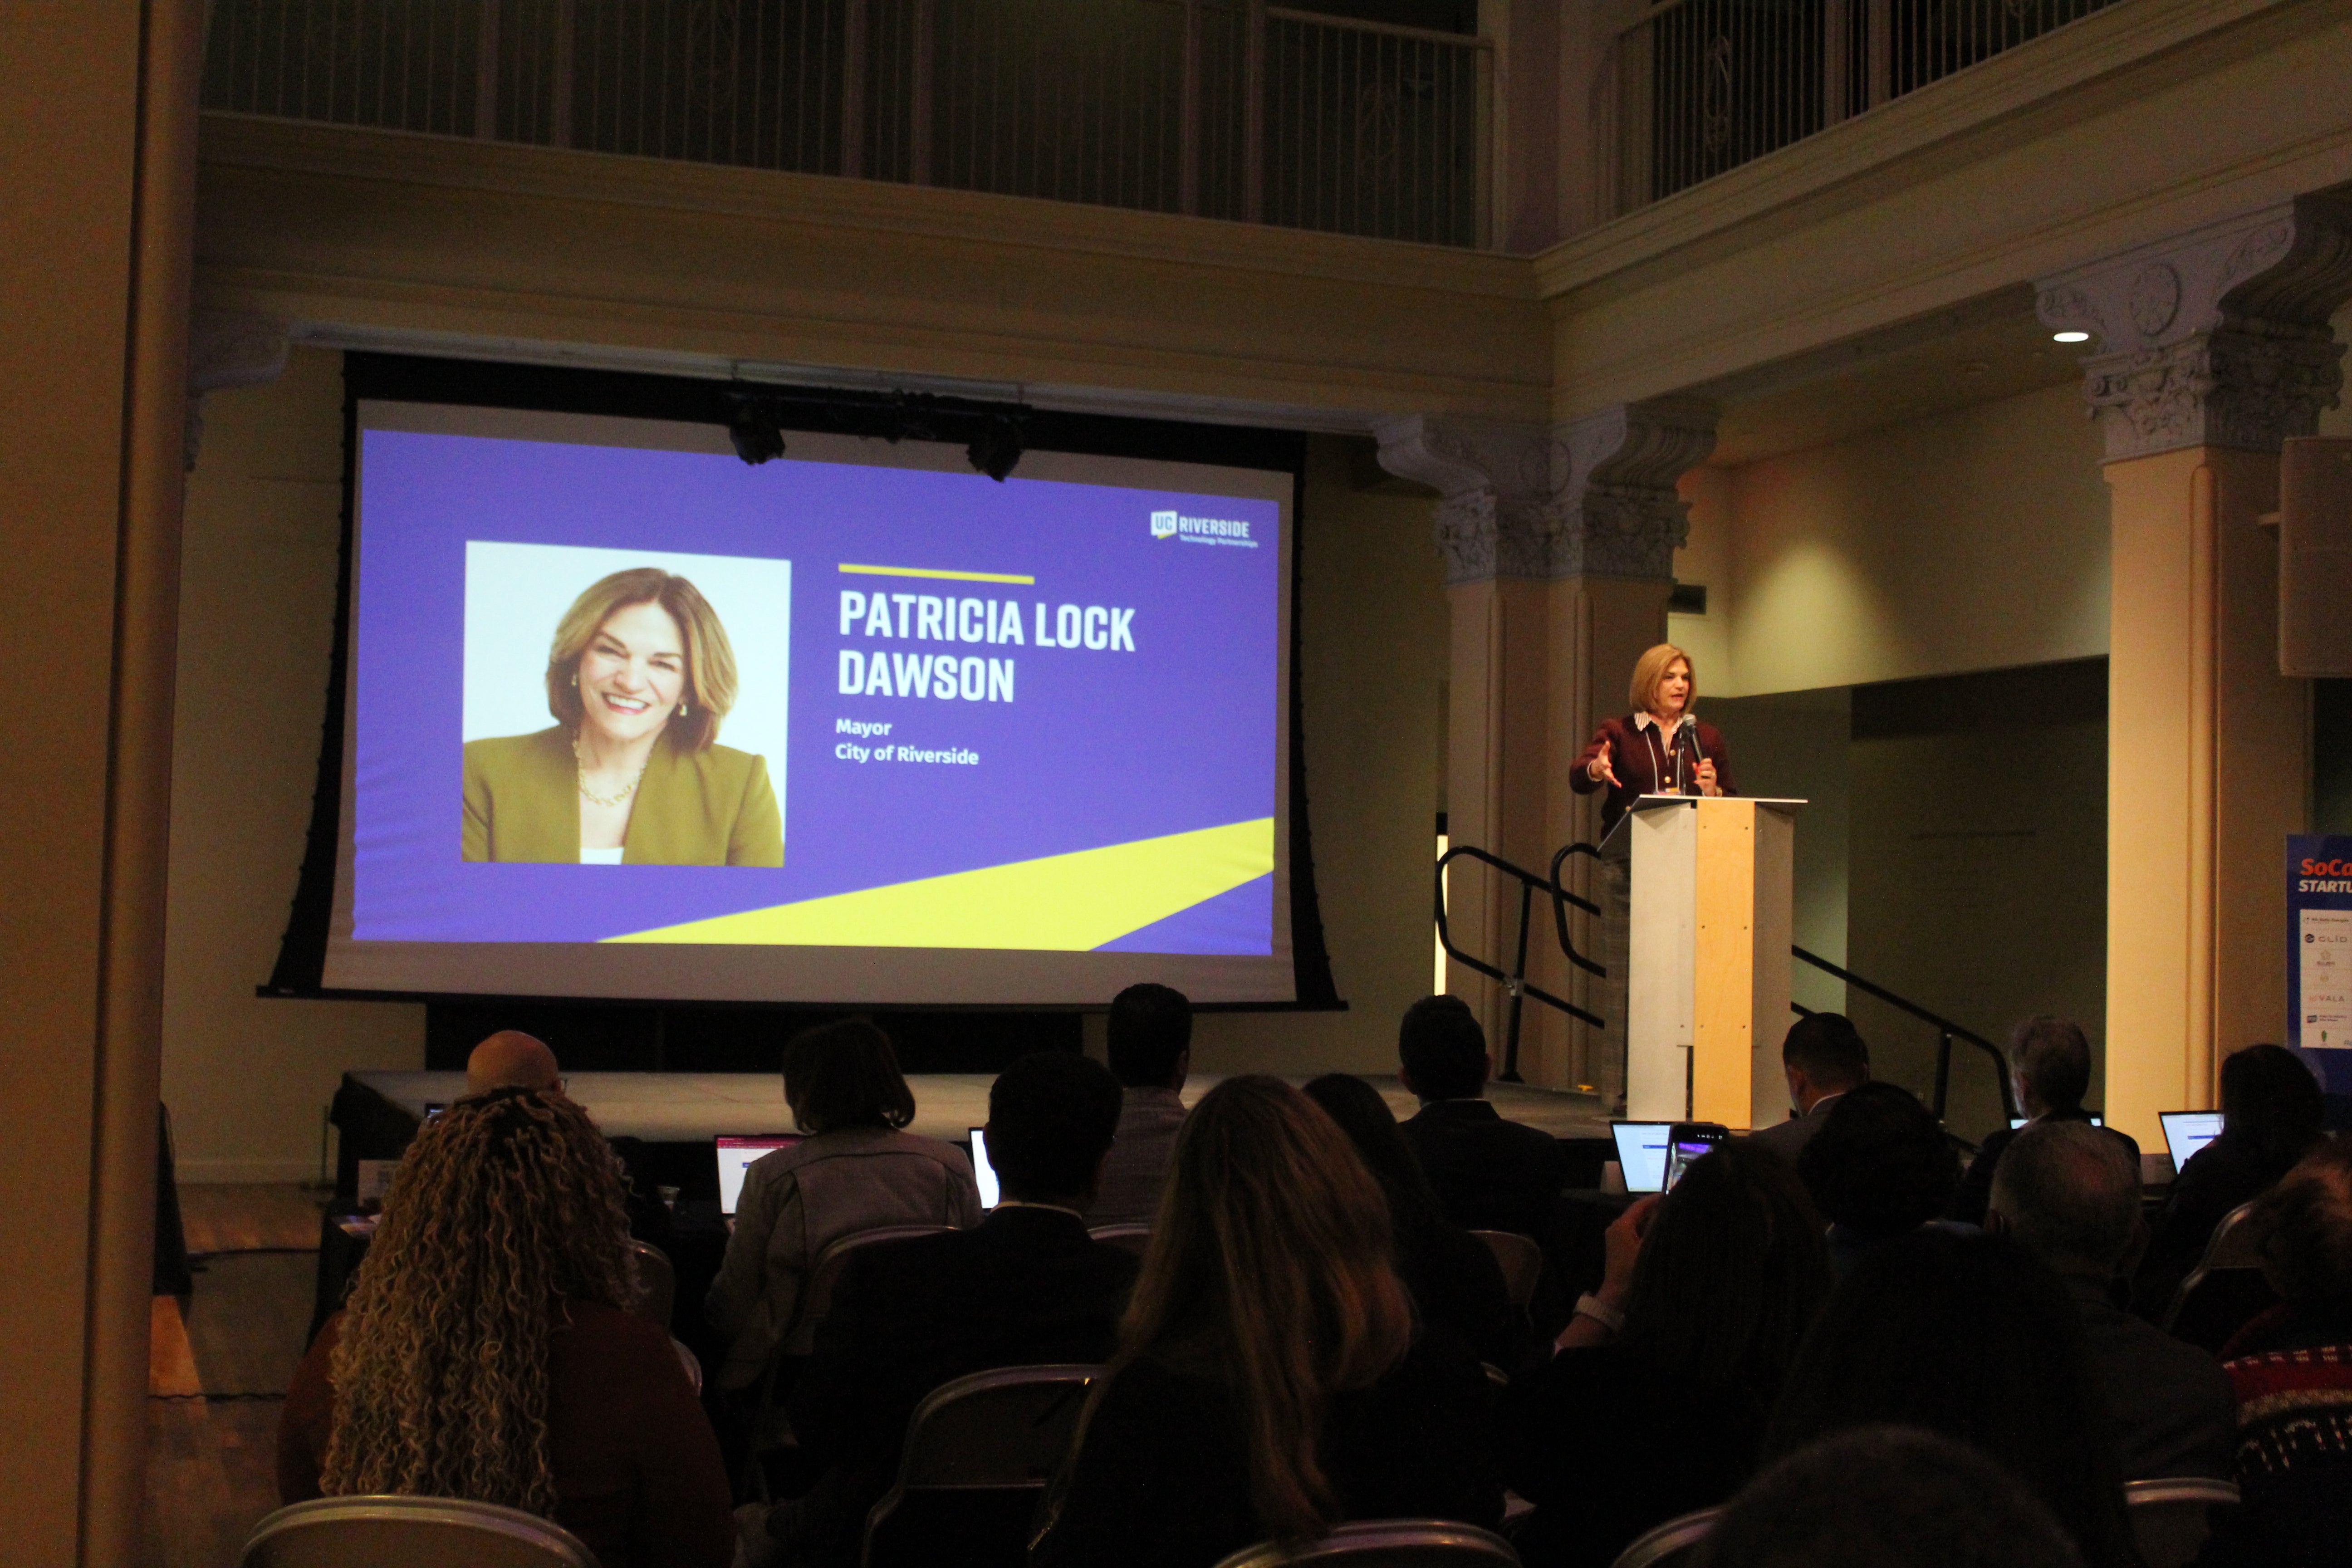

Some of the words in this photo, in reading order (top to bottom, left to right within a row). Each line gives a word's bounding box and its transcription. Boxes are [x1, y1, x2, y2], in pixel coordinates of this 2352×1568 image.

[1156, 516, 1173, 530] UC
[1179, 516, 1250, 538] RIVERSIDE
[839, 590, 1025, 646] PATRICIA
[1035, 602, 1136, 652] LOCK
[838, 649, 1015, 703] DAWSON
[835, 717, 893, 739] Mayor
[834, 741, 872, 764] City
[873, 744, 896, 761] of
[897, 744, 980, 765] Riverside
